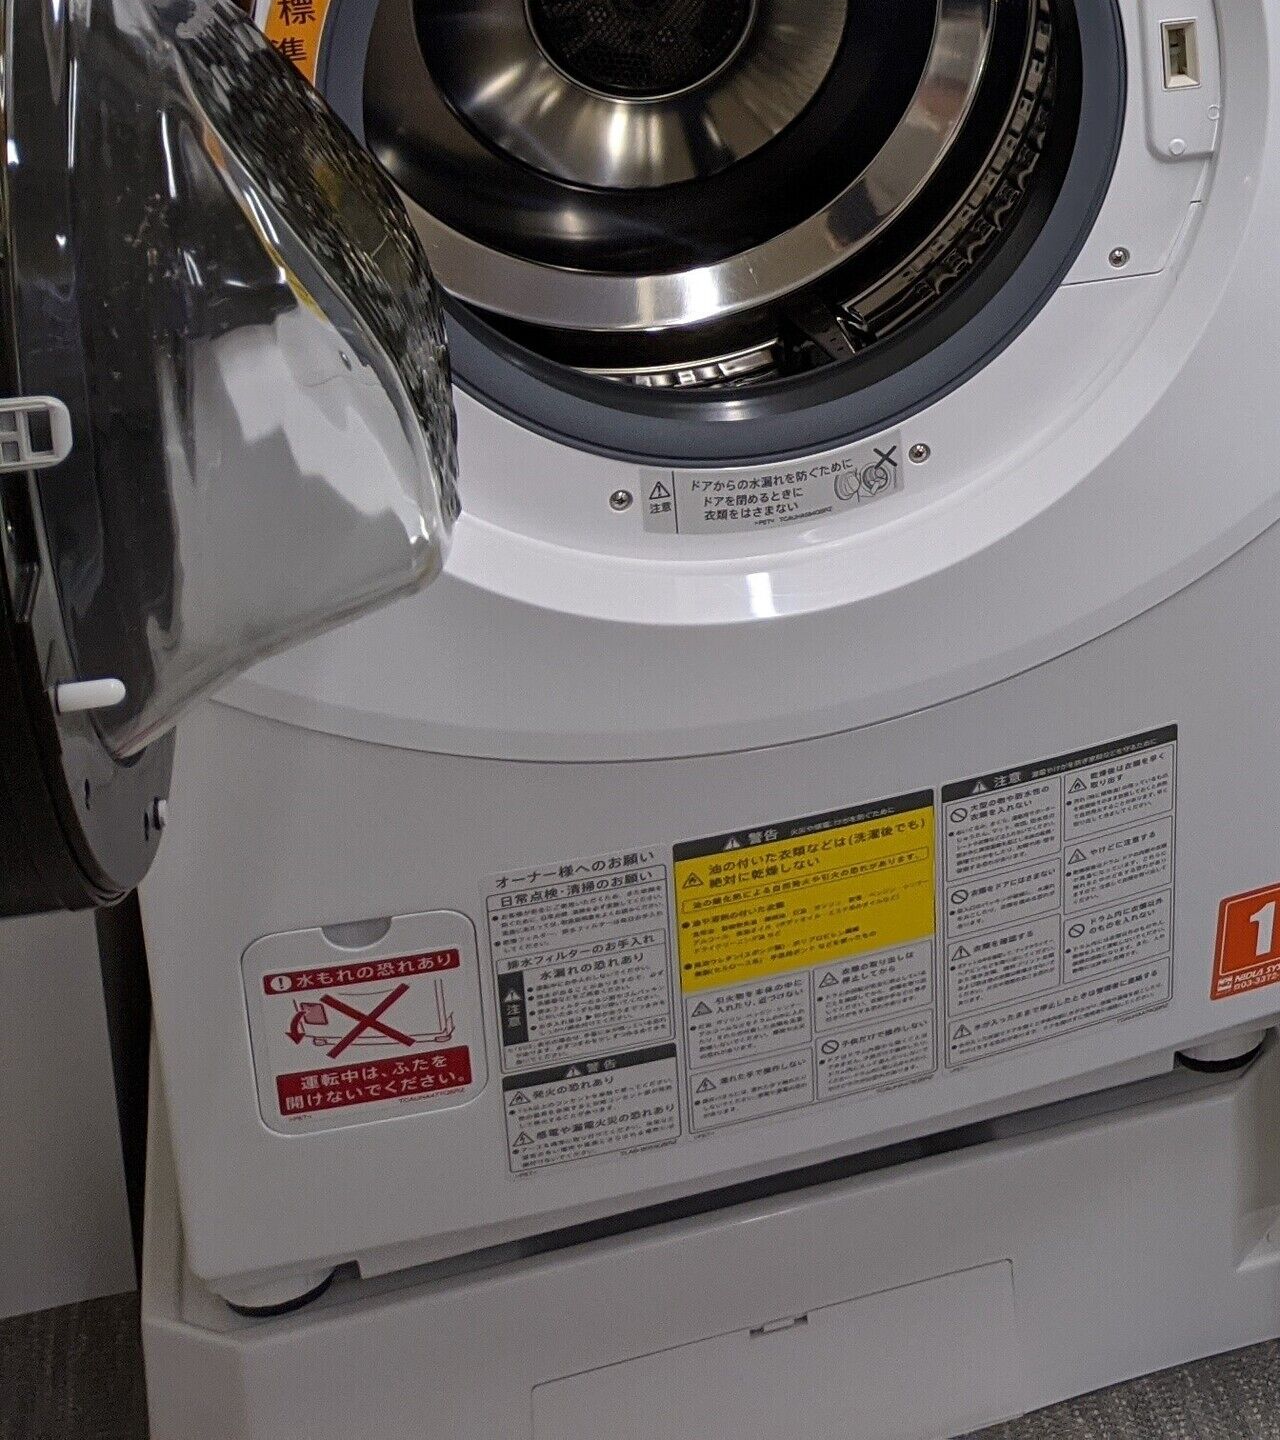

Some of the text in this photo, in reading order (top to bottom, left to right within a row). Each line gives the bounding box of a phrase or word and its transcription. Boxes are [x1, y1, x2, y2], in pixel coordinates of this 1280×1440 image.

[691, 458, 854, 492] ドアからの水漏れを防ぐために
[650, 501, 672, 515] 注意
[702, 487, 804, 508] ドアを閉めるときに
[704, 502, 800, 522] 衣類をはさまない
[495, 851, 655, 889] オーナー様へのお願い
[708, 856, 820, 888] 絶対に乾燥しない
[1250, 901, 1276, 957] 1
[296, 952, 451, 989] 水もれの恐れあり
[301, 1055, 448, 1091] 運転中は、ふたを
[285, 1071, 465, 1111] 開けないでください。
